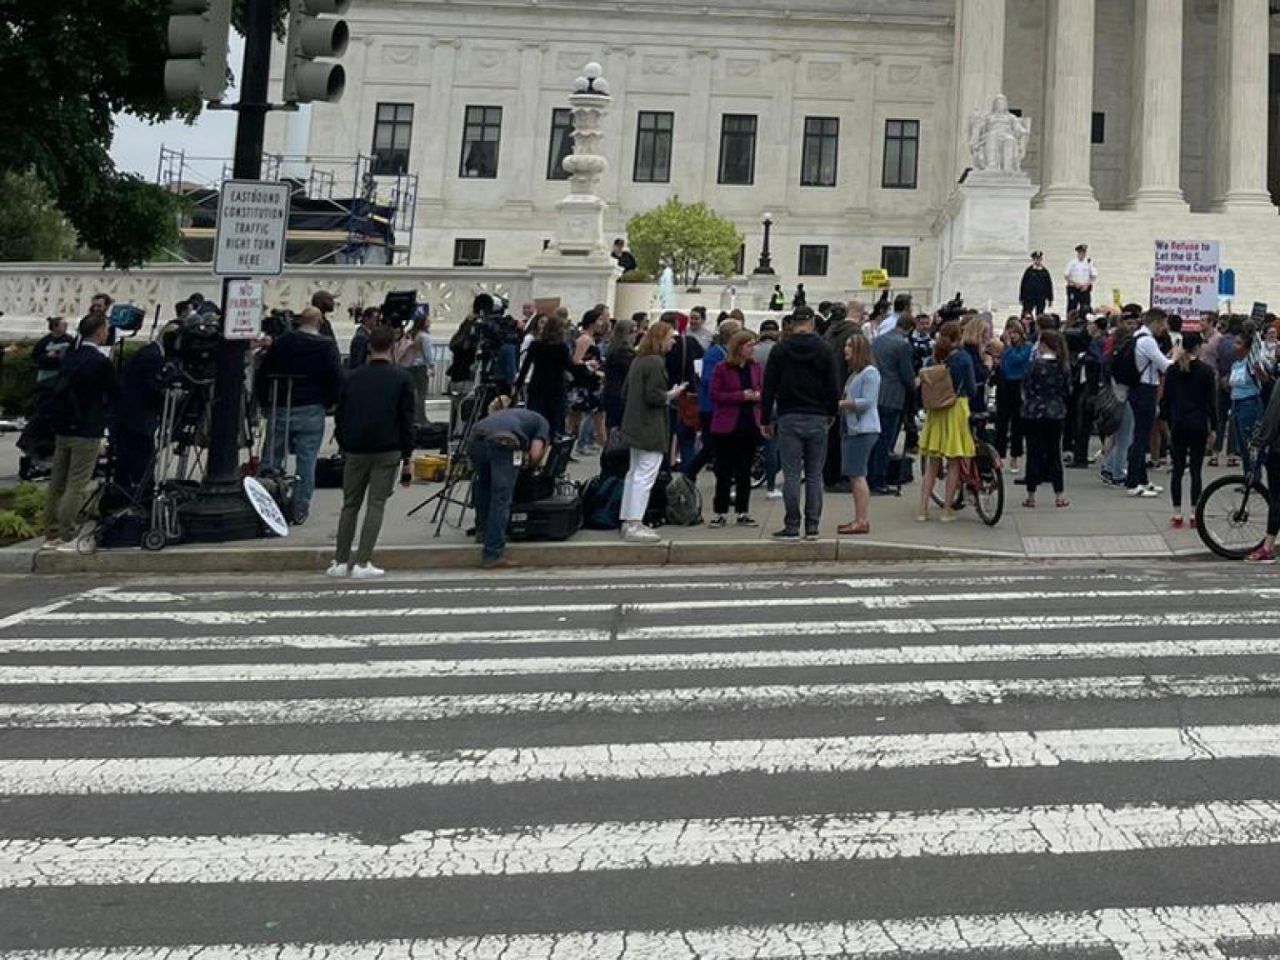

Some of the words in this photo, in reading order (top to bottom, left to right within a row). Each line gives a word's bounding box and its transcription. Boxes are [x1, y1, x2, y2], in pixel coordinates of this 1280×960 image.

[230, 190, 280, 205] EASTBOUND
[223, 206, 283, 219] CONSTITUTION
[234, 222, 270, 234] TRAFFIC
[225, 238, 251, 250] RIGHT
[253, 239, 275, 250] TURN
[1155, 241, 1169, 250] We
[1171, 241, 1199, 251] Refuse
[1201, 242, 1210, 251] to
[237, 253, 260, 266] HERE
[1155, 251, 1169, 260] Let
[1171, 252, 1184, 260] the
[1186, 252, 1202, 261] U.S.
[1155, 262, 1191, 273] Supreme
[1193, 263, 1217, 273] Court
[1154, 273, 1175, 284] Deny
[1177, 274, 1215, 283] Women's
[239, 285, 254, 296] NO
[1154, 284, 1193, 296] Humanity
[1195, 285, 1202, 294] &
[229, 298, 260, 308] PARKING
[1153, 295, 1192, 305] Decimate
